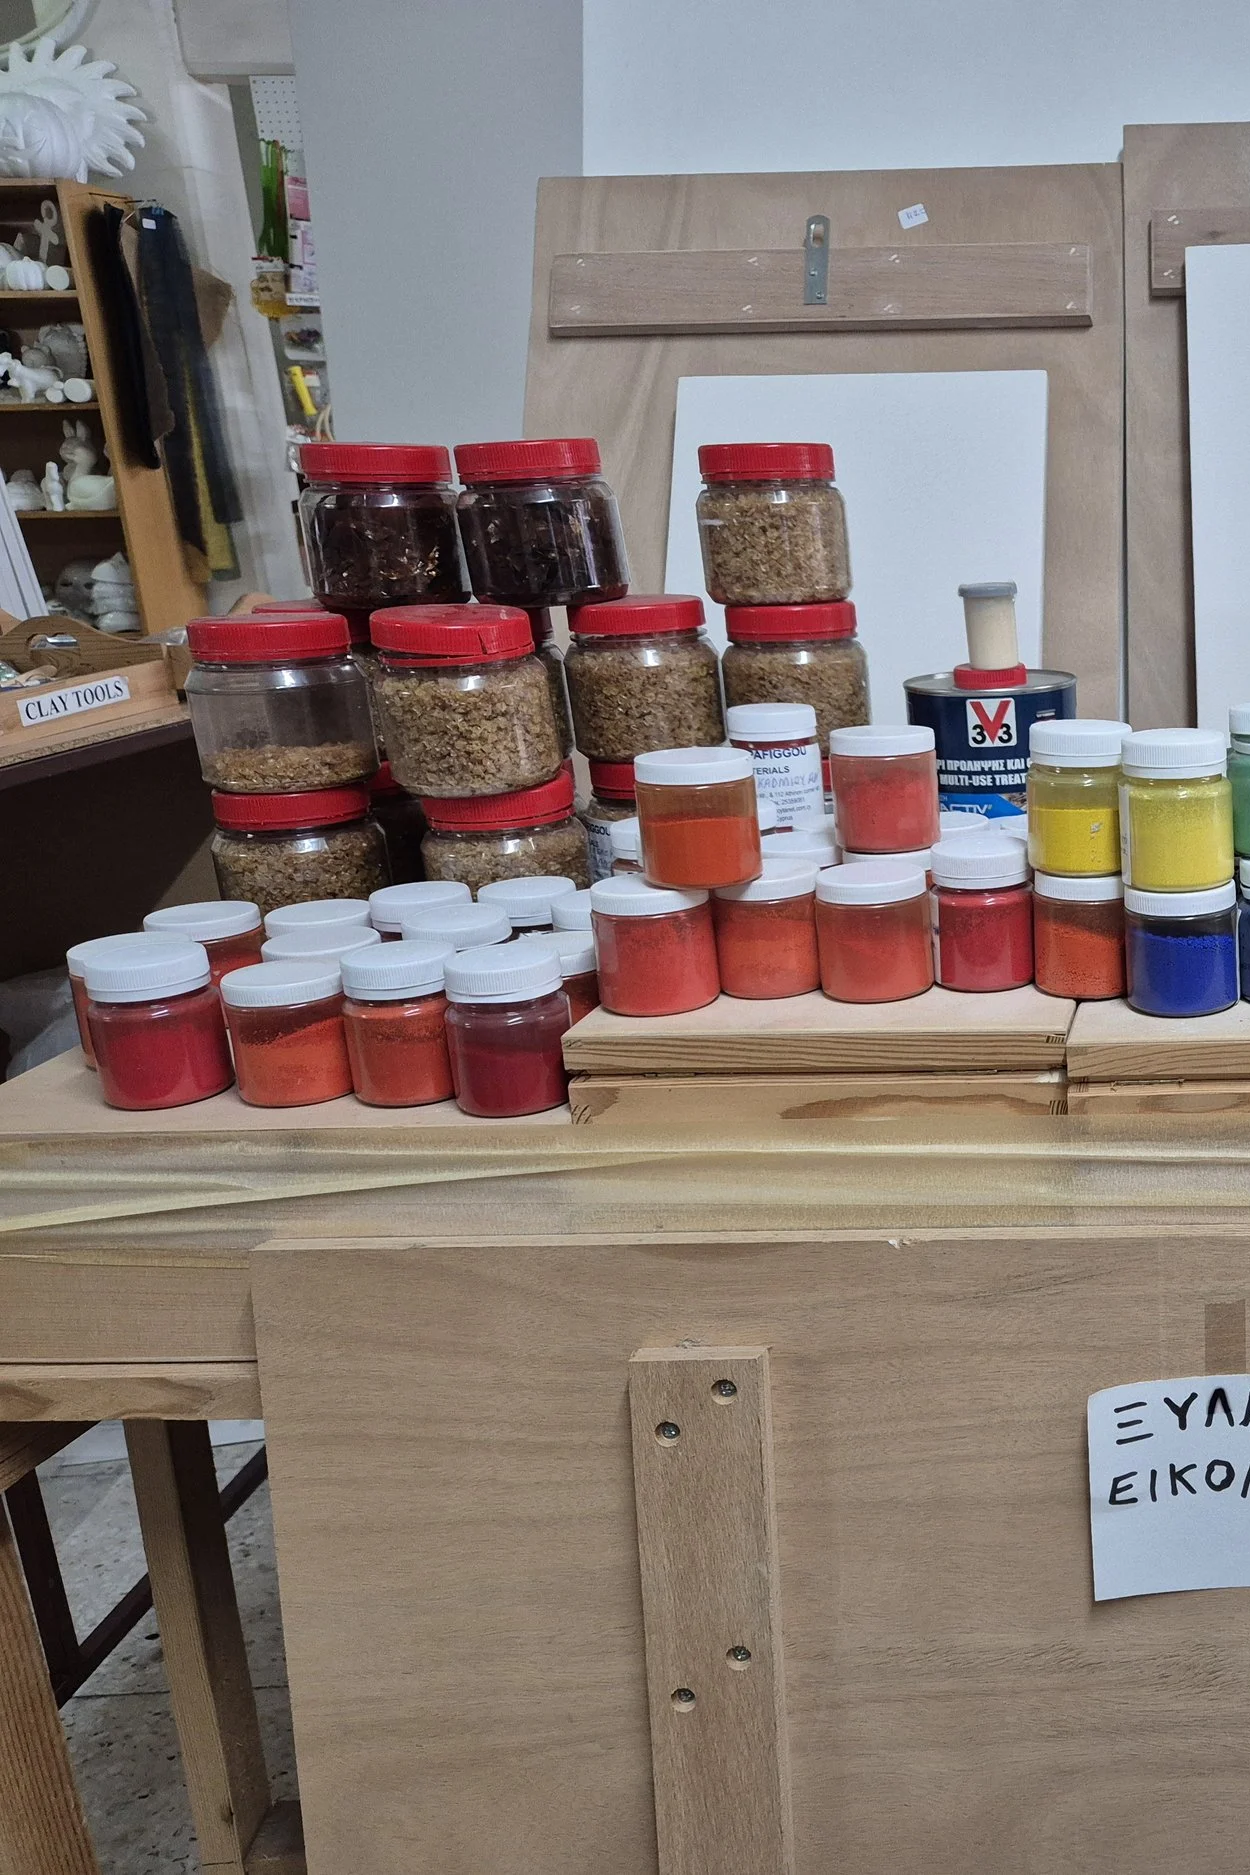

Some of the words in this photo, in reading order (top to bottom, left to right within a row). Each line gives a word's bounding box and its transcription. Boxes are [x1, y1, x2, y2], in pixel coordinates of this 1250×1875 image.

[25, 694, 68, 720] CLAY
[72, 681, 124, 708] TOOLS
[939, 773, 993, 787] MULTI-USE
